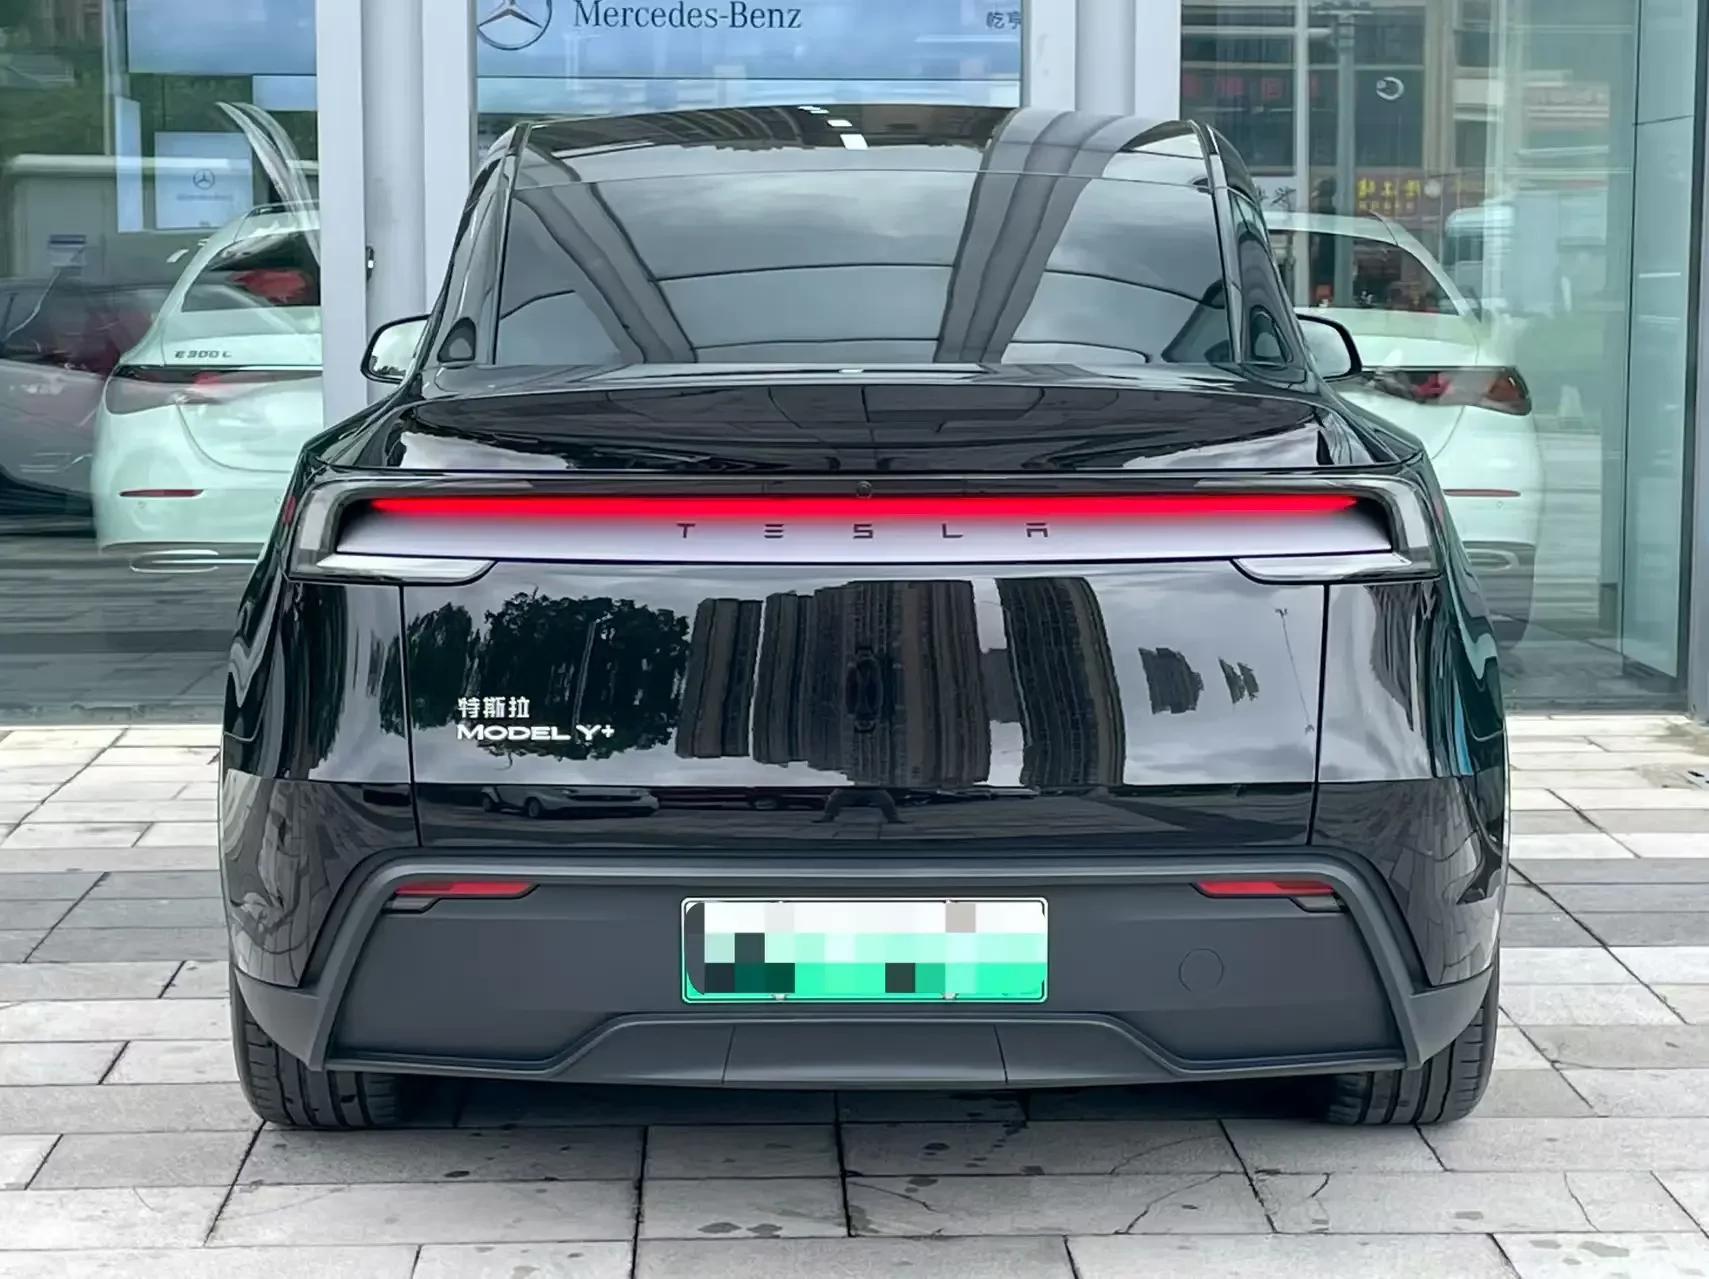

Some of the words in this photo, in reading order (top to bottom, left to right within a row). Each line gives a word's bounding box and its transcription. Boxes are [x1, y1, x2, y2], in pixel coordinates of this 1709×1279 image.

[573, 0, 802, 29] Mercedes-Benz
[676, 522, 1049, 539] TESLA
[457, 696, 531, 719] 特斯拉
[456, 723, 571, 742] MODEL
[575, 723, 616, 742] Y+
